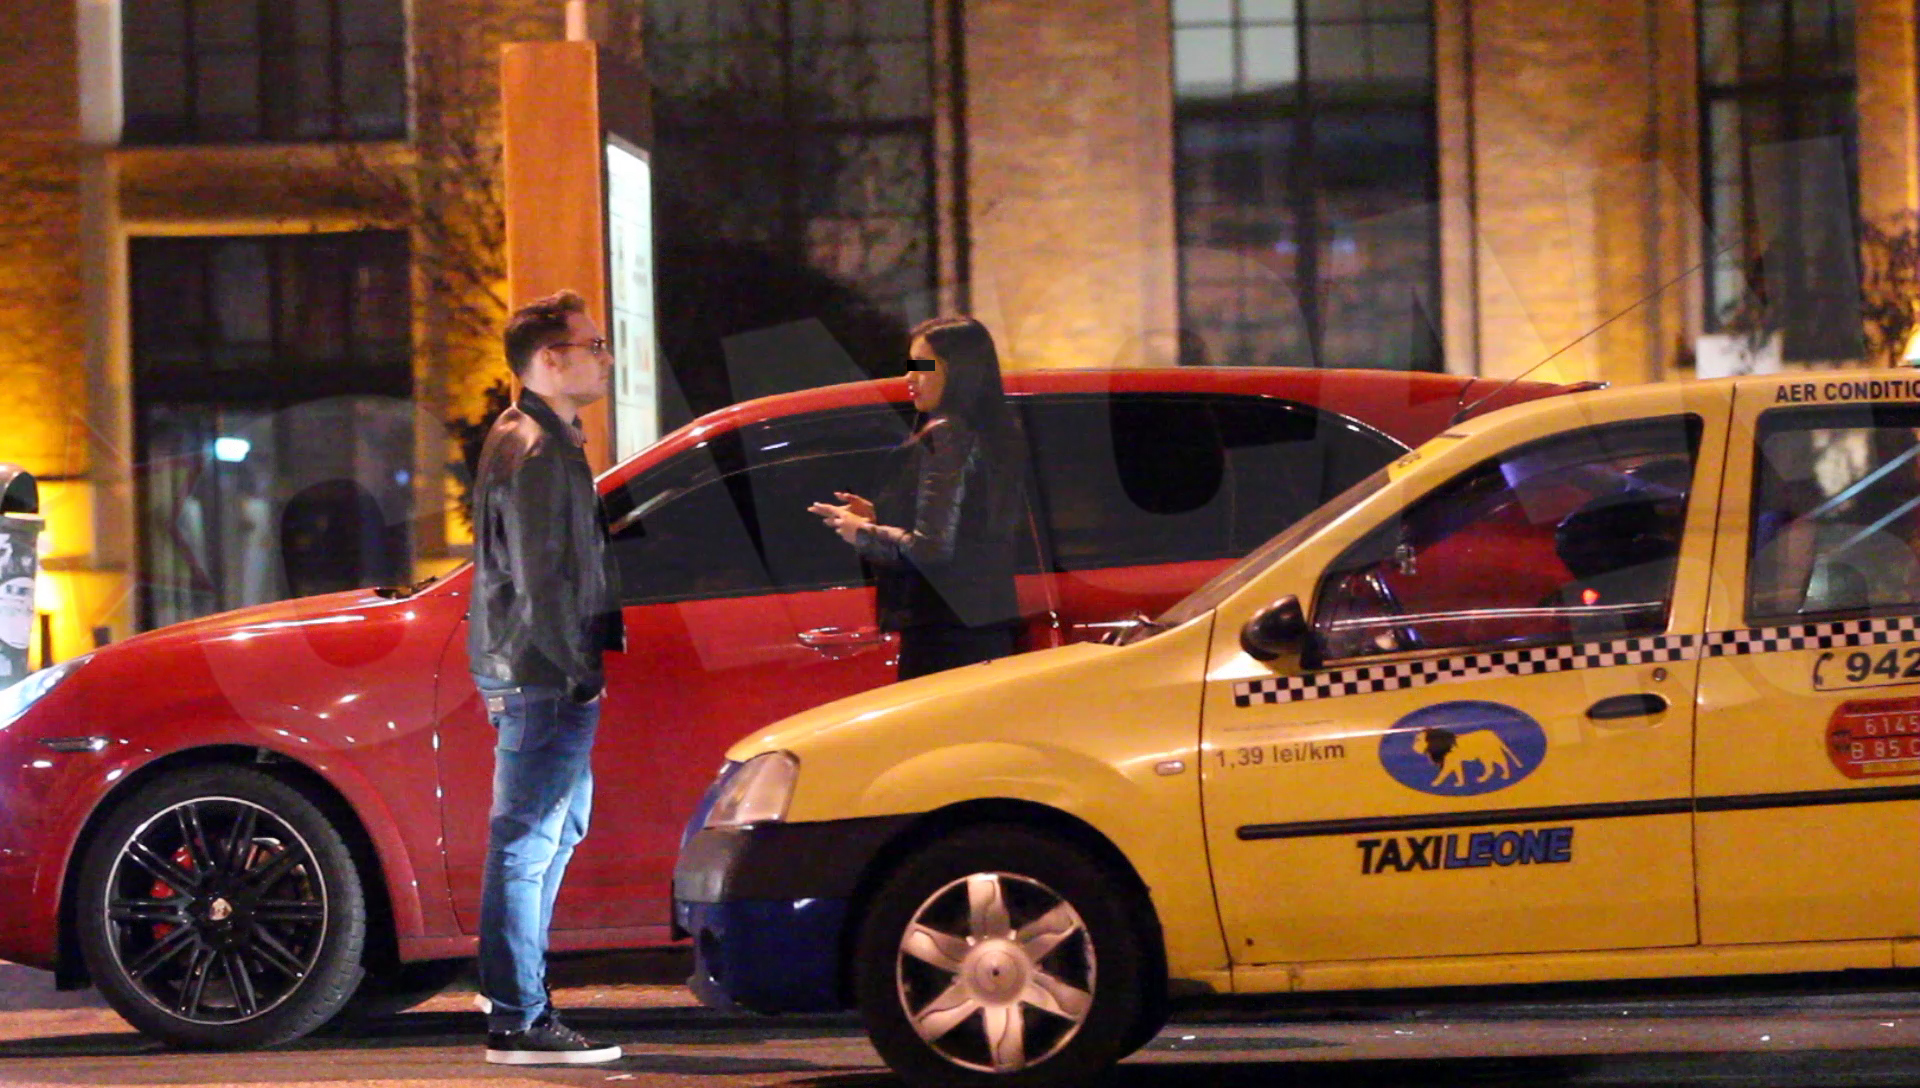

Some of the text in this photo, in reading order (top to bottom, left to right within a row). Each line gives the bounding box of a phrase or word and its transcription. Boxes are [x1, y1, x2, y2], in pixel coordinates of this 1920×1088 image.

[1775, 384, 1817, 402] AER
[1846, 648, 1920, 682] 942
[1215, 742, 1345, 769] 1,39 lei/km
[1850, 742, 1864, 759] B
